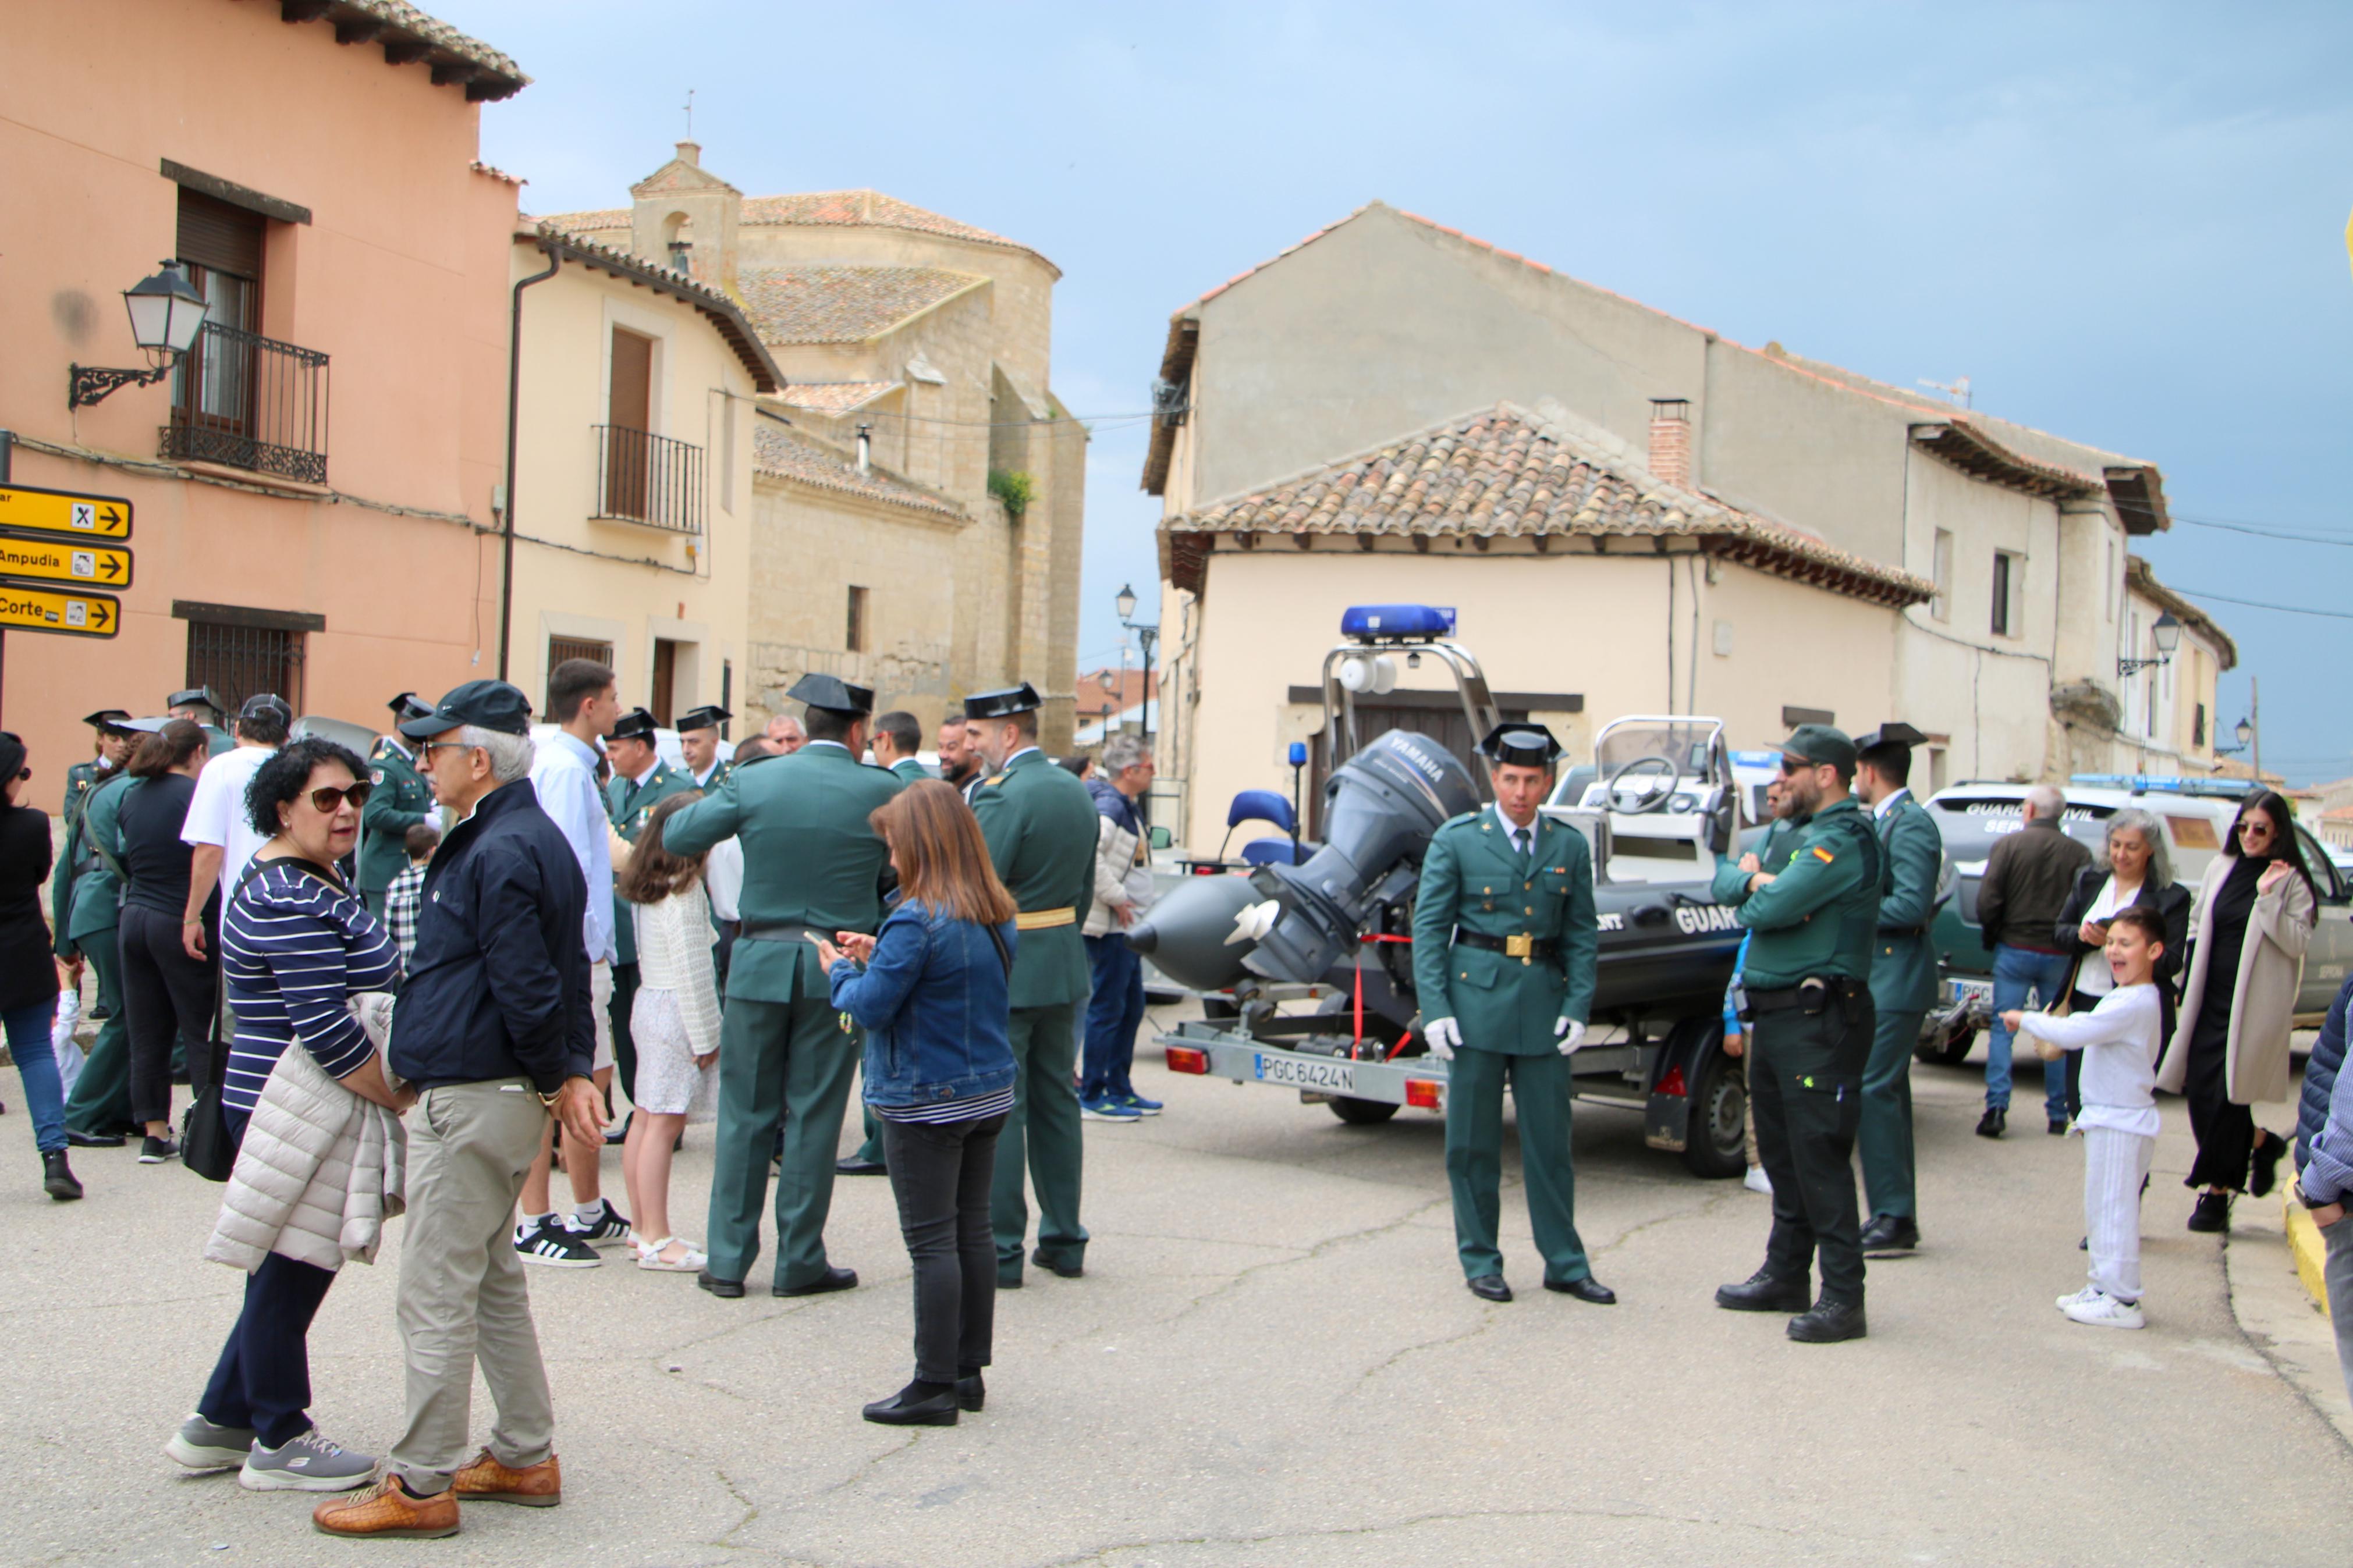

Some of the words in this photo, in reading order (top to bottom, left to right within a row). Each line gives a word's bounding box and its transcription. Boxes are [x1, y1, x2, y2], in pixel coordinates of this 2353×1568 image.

[0, 494, 12, 502] ar
[0, 549, 60, 567] Ampudia
[0, 598, 42, 617] Corte
[1390, 736, 1444, 783] YAMAHA
[2061, 808, 2094, 822] IVIL
[1675, 905, 1744, 934] GUAR
[1263, 1058, 1353, 1089] PGC6424N
